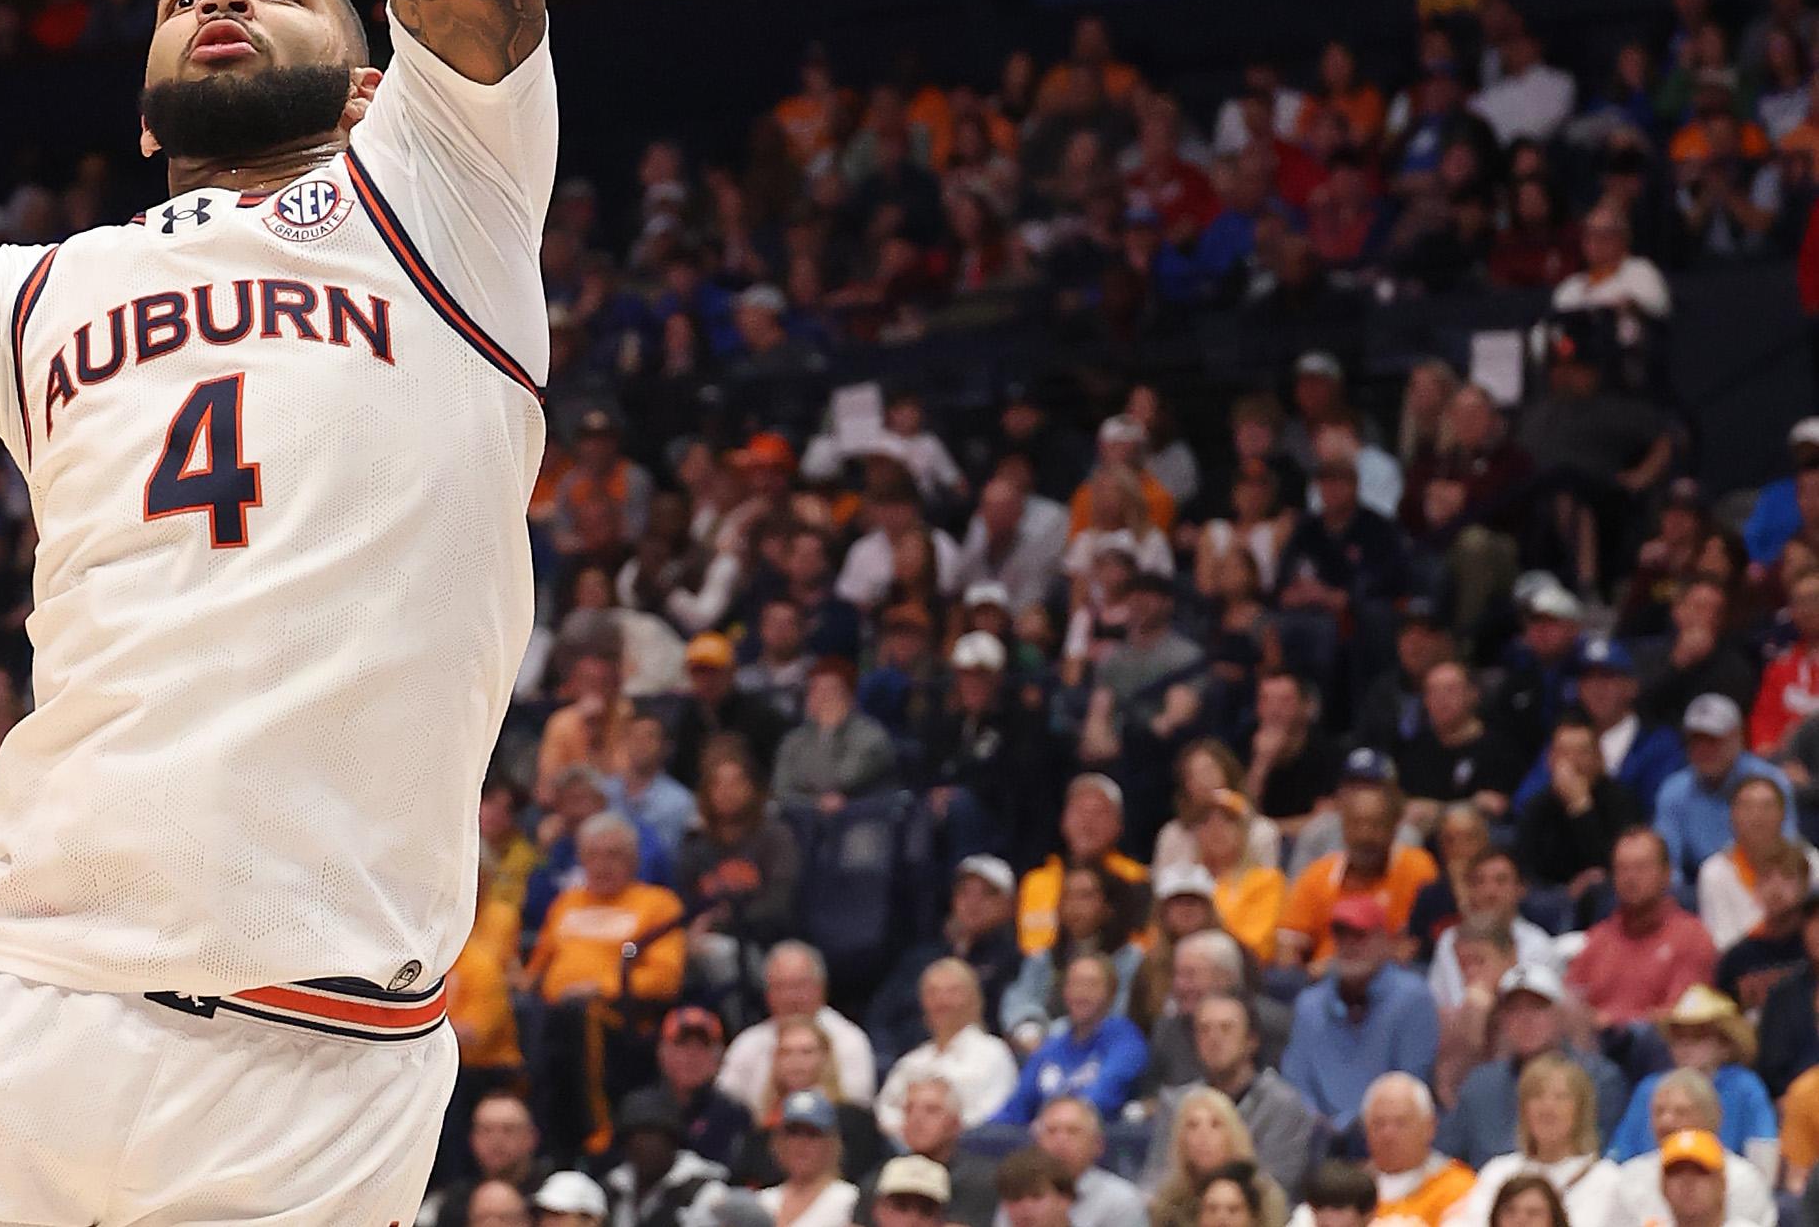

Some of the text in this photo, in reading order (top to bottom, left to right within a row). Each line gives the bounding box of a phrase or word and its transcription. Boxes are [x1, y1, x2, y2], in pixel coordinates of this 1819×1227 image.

[274, 213, 342, 240] GRADUATE
[279, 181, 335, 224] SEC
[46, 278, 396, 442] AUBURN
[143, 371, 263, 550] 4
